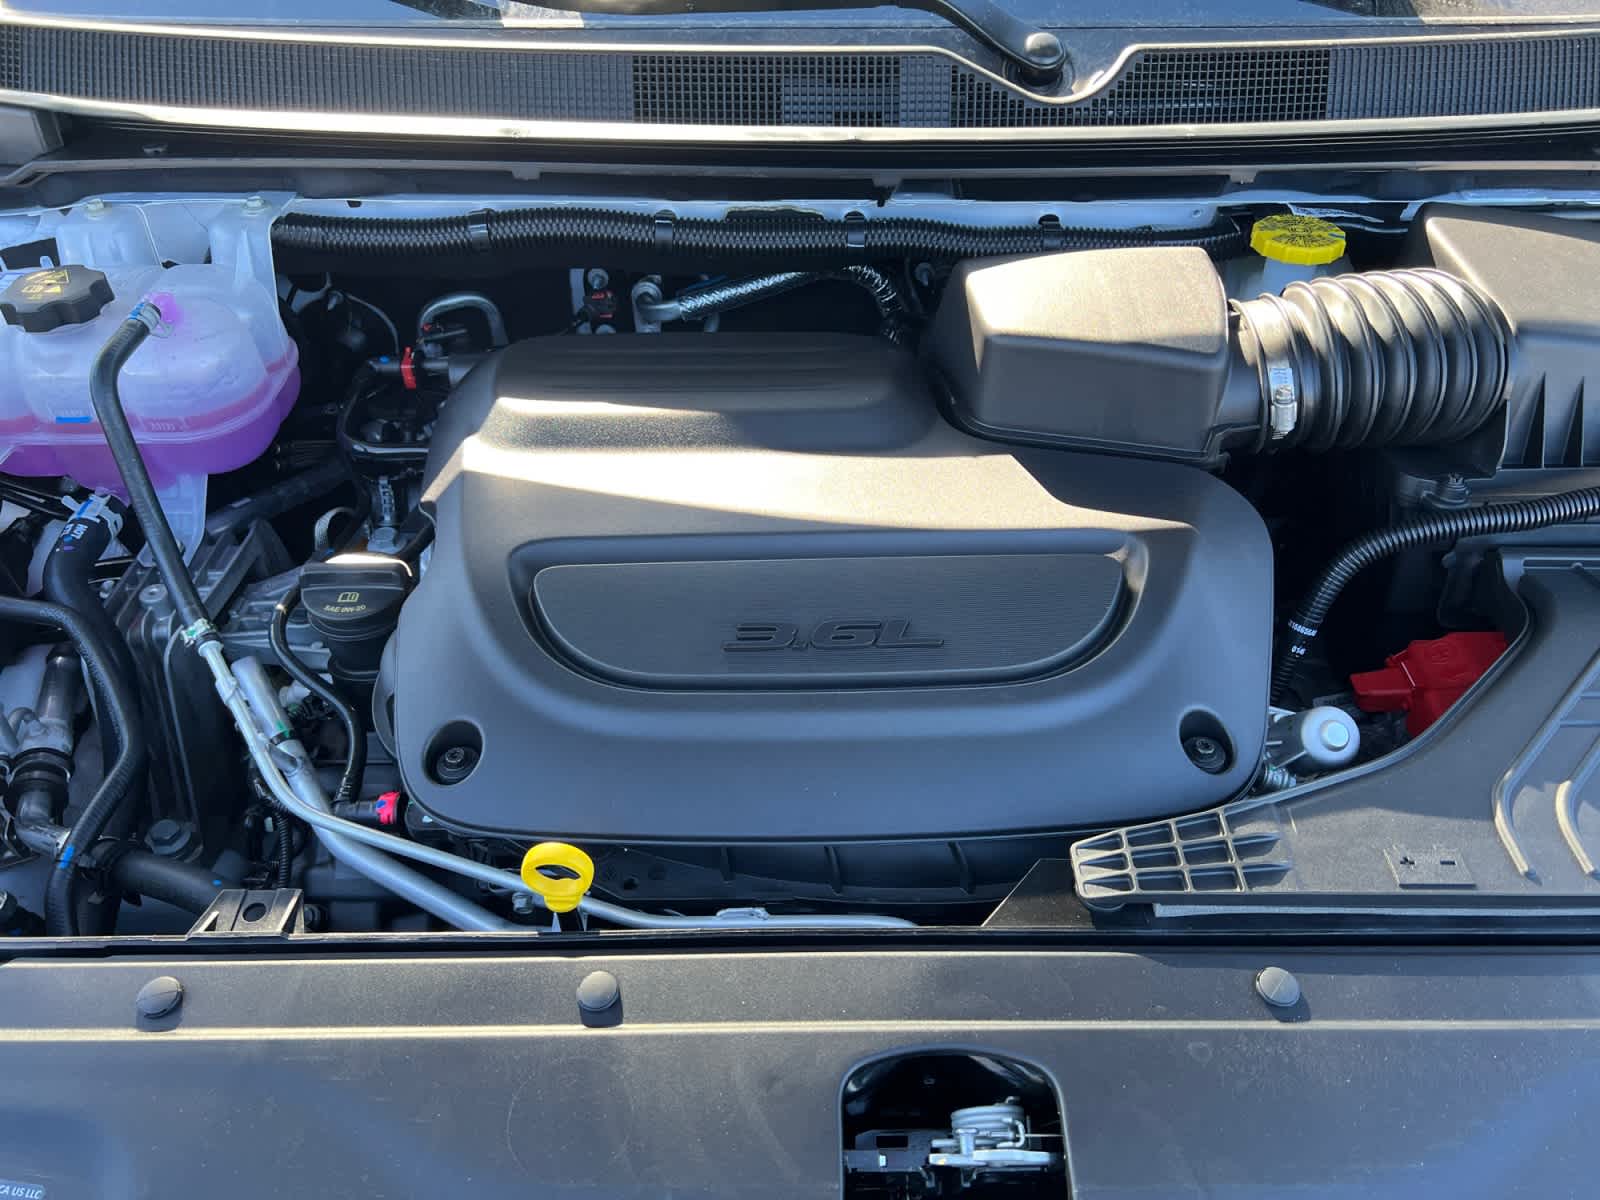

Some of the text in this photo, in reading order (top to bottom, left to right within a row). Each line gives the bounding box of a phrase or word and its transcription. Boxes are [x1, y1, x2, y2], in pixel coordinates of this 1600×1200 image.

[323, 604, 340, 613] SAE
[721, 616, 945, 652] 3.6L
[11, 1186, 25, 1197] US
[25, 1188, 42, 1200] LLC
